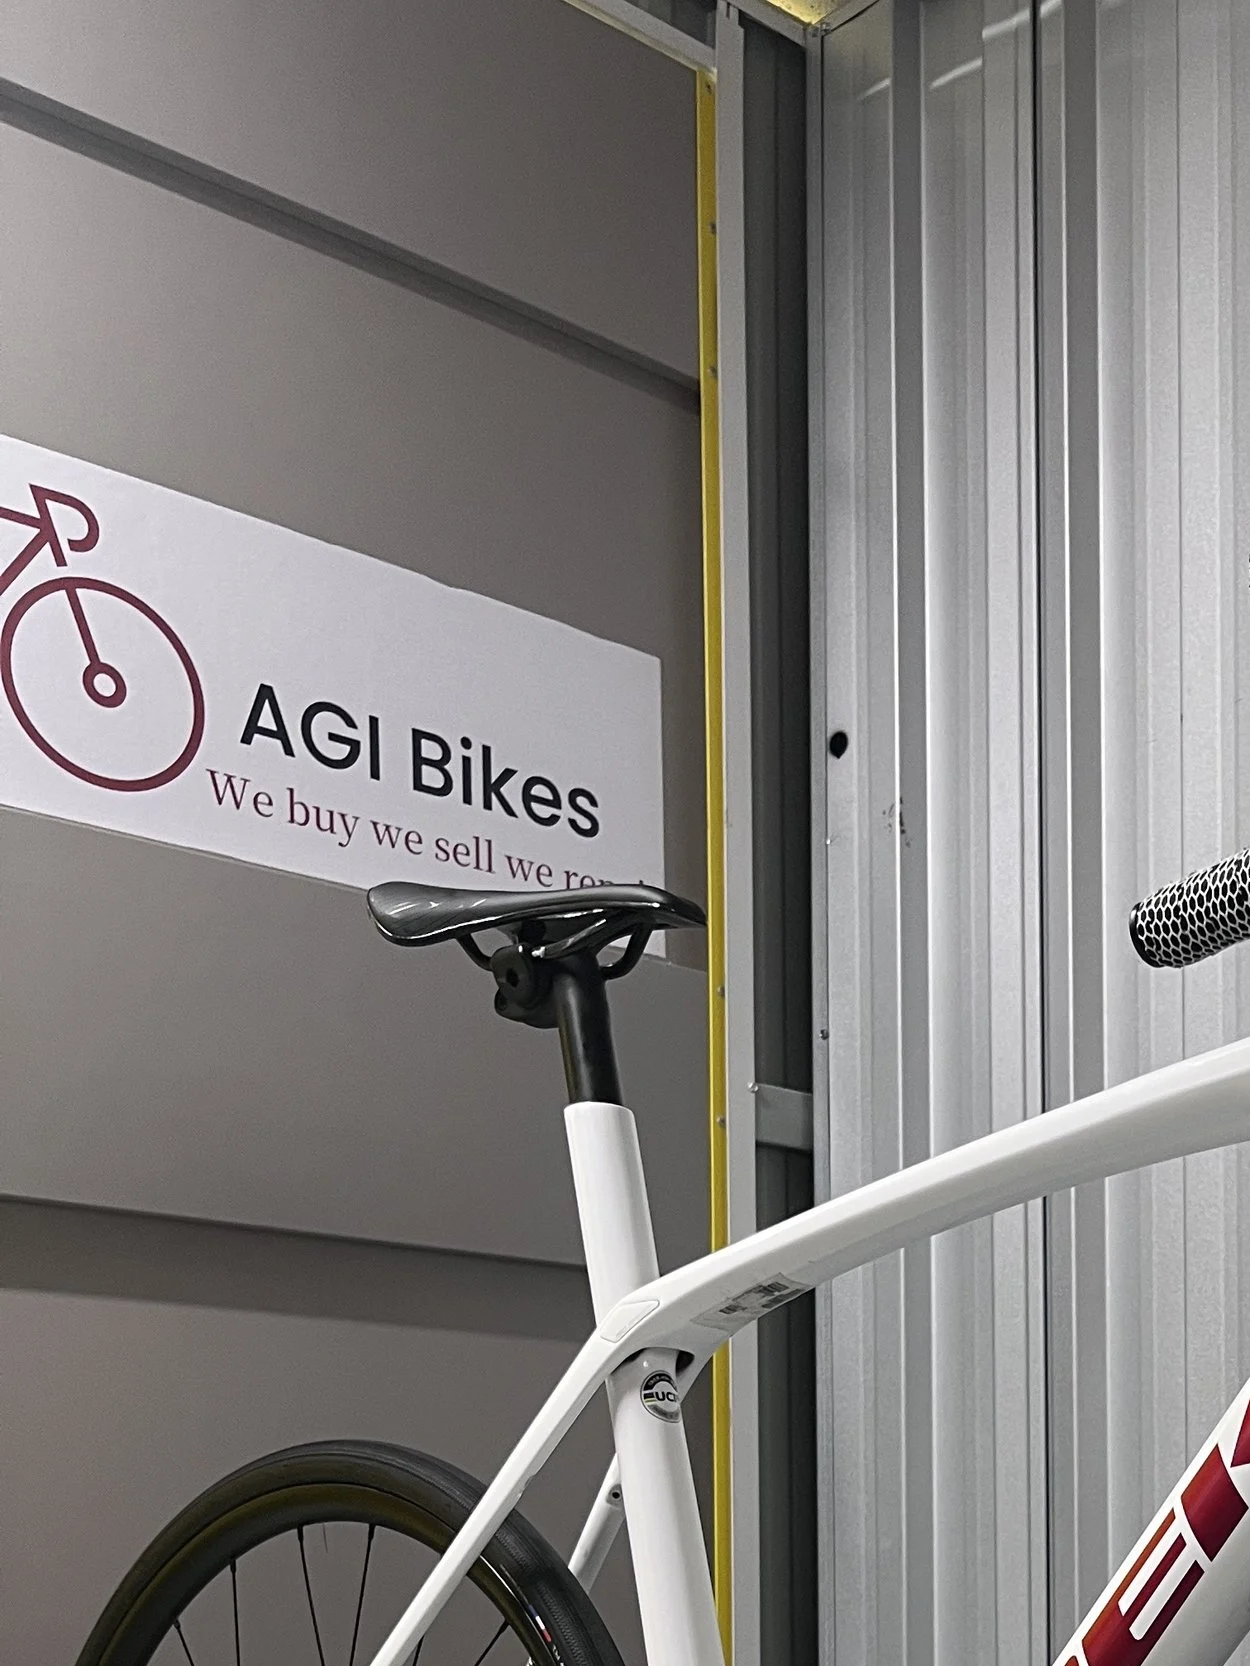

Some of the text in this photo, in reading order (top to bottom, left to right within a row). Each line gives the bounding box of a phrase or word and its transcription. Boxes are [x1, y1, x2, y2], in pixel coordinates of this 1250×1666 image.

[205, 767, 274, 818] We
[285, 787, 360, 848] buy
[369, 819, 424, 856] we
[434, 835, 496, 874] sell
[504, 854, 553, 888] we
[239, 682, 600, 838] AGI Bikes
